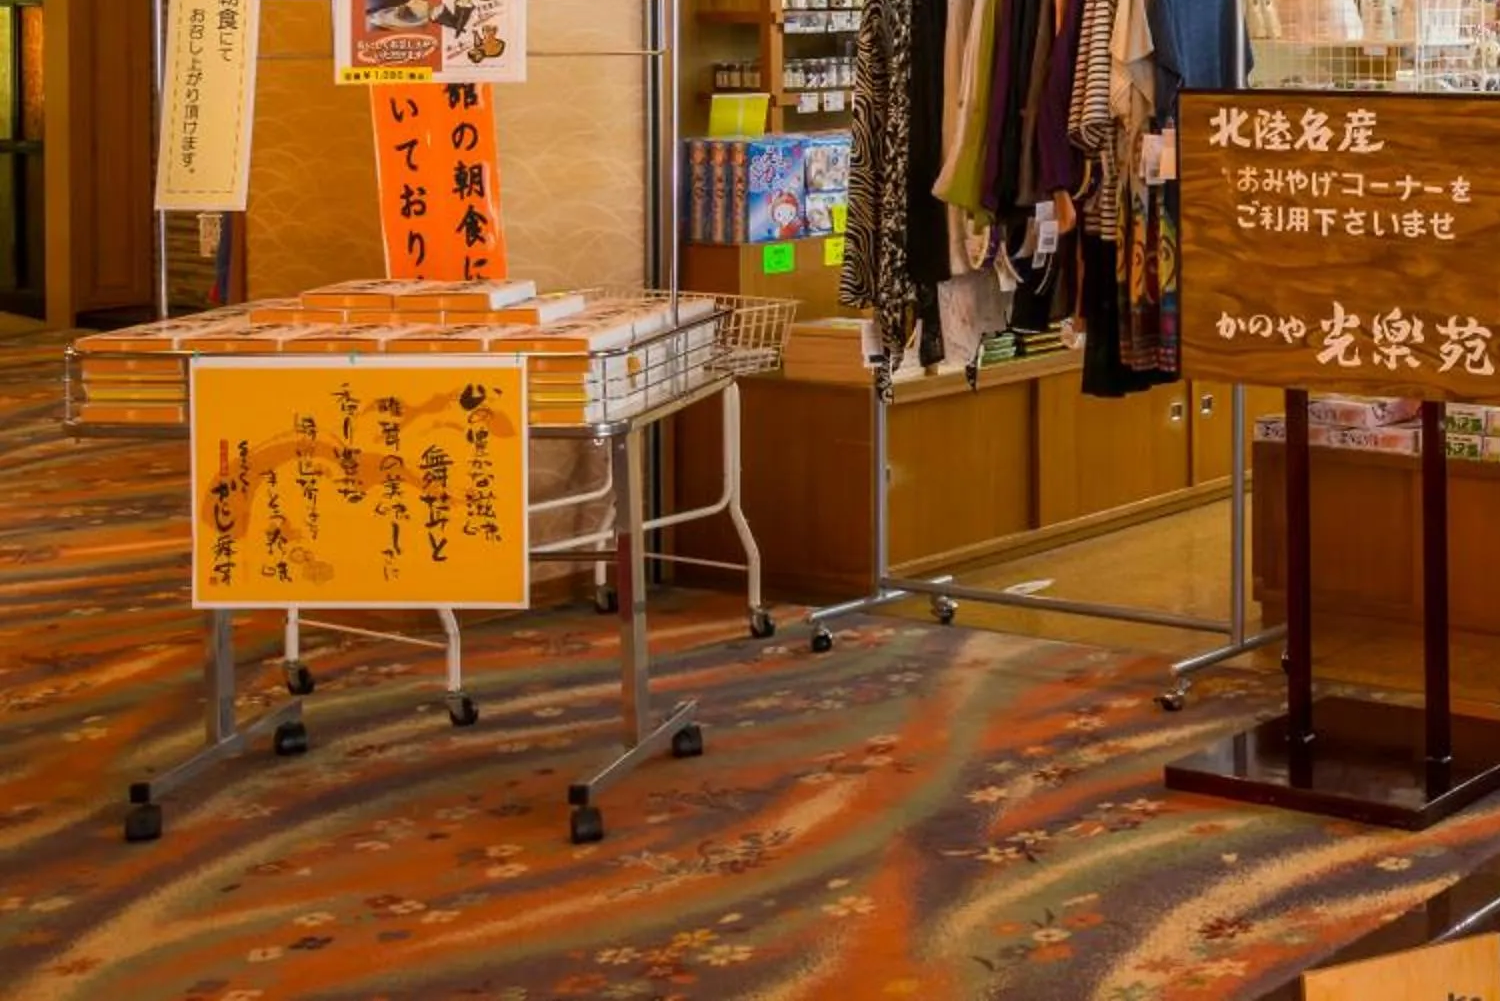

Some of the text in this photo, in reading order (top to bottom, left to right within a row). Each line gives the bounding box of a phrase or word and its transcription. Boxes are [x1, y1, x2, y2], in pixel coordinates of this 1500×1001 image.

[180, 8, 206, 174] お召し上がり頂けます。
[1208, 107, 1385, 153] 北陸名産
[389, 98, 428, 280] いており
[1235, 166, 1472, 203] おみやげコーナーを
[1235, 200, 1457, 240] ご利用下さいませ
